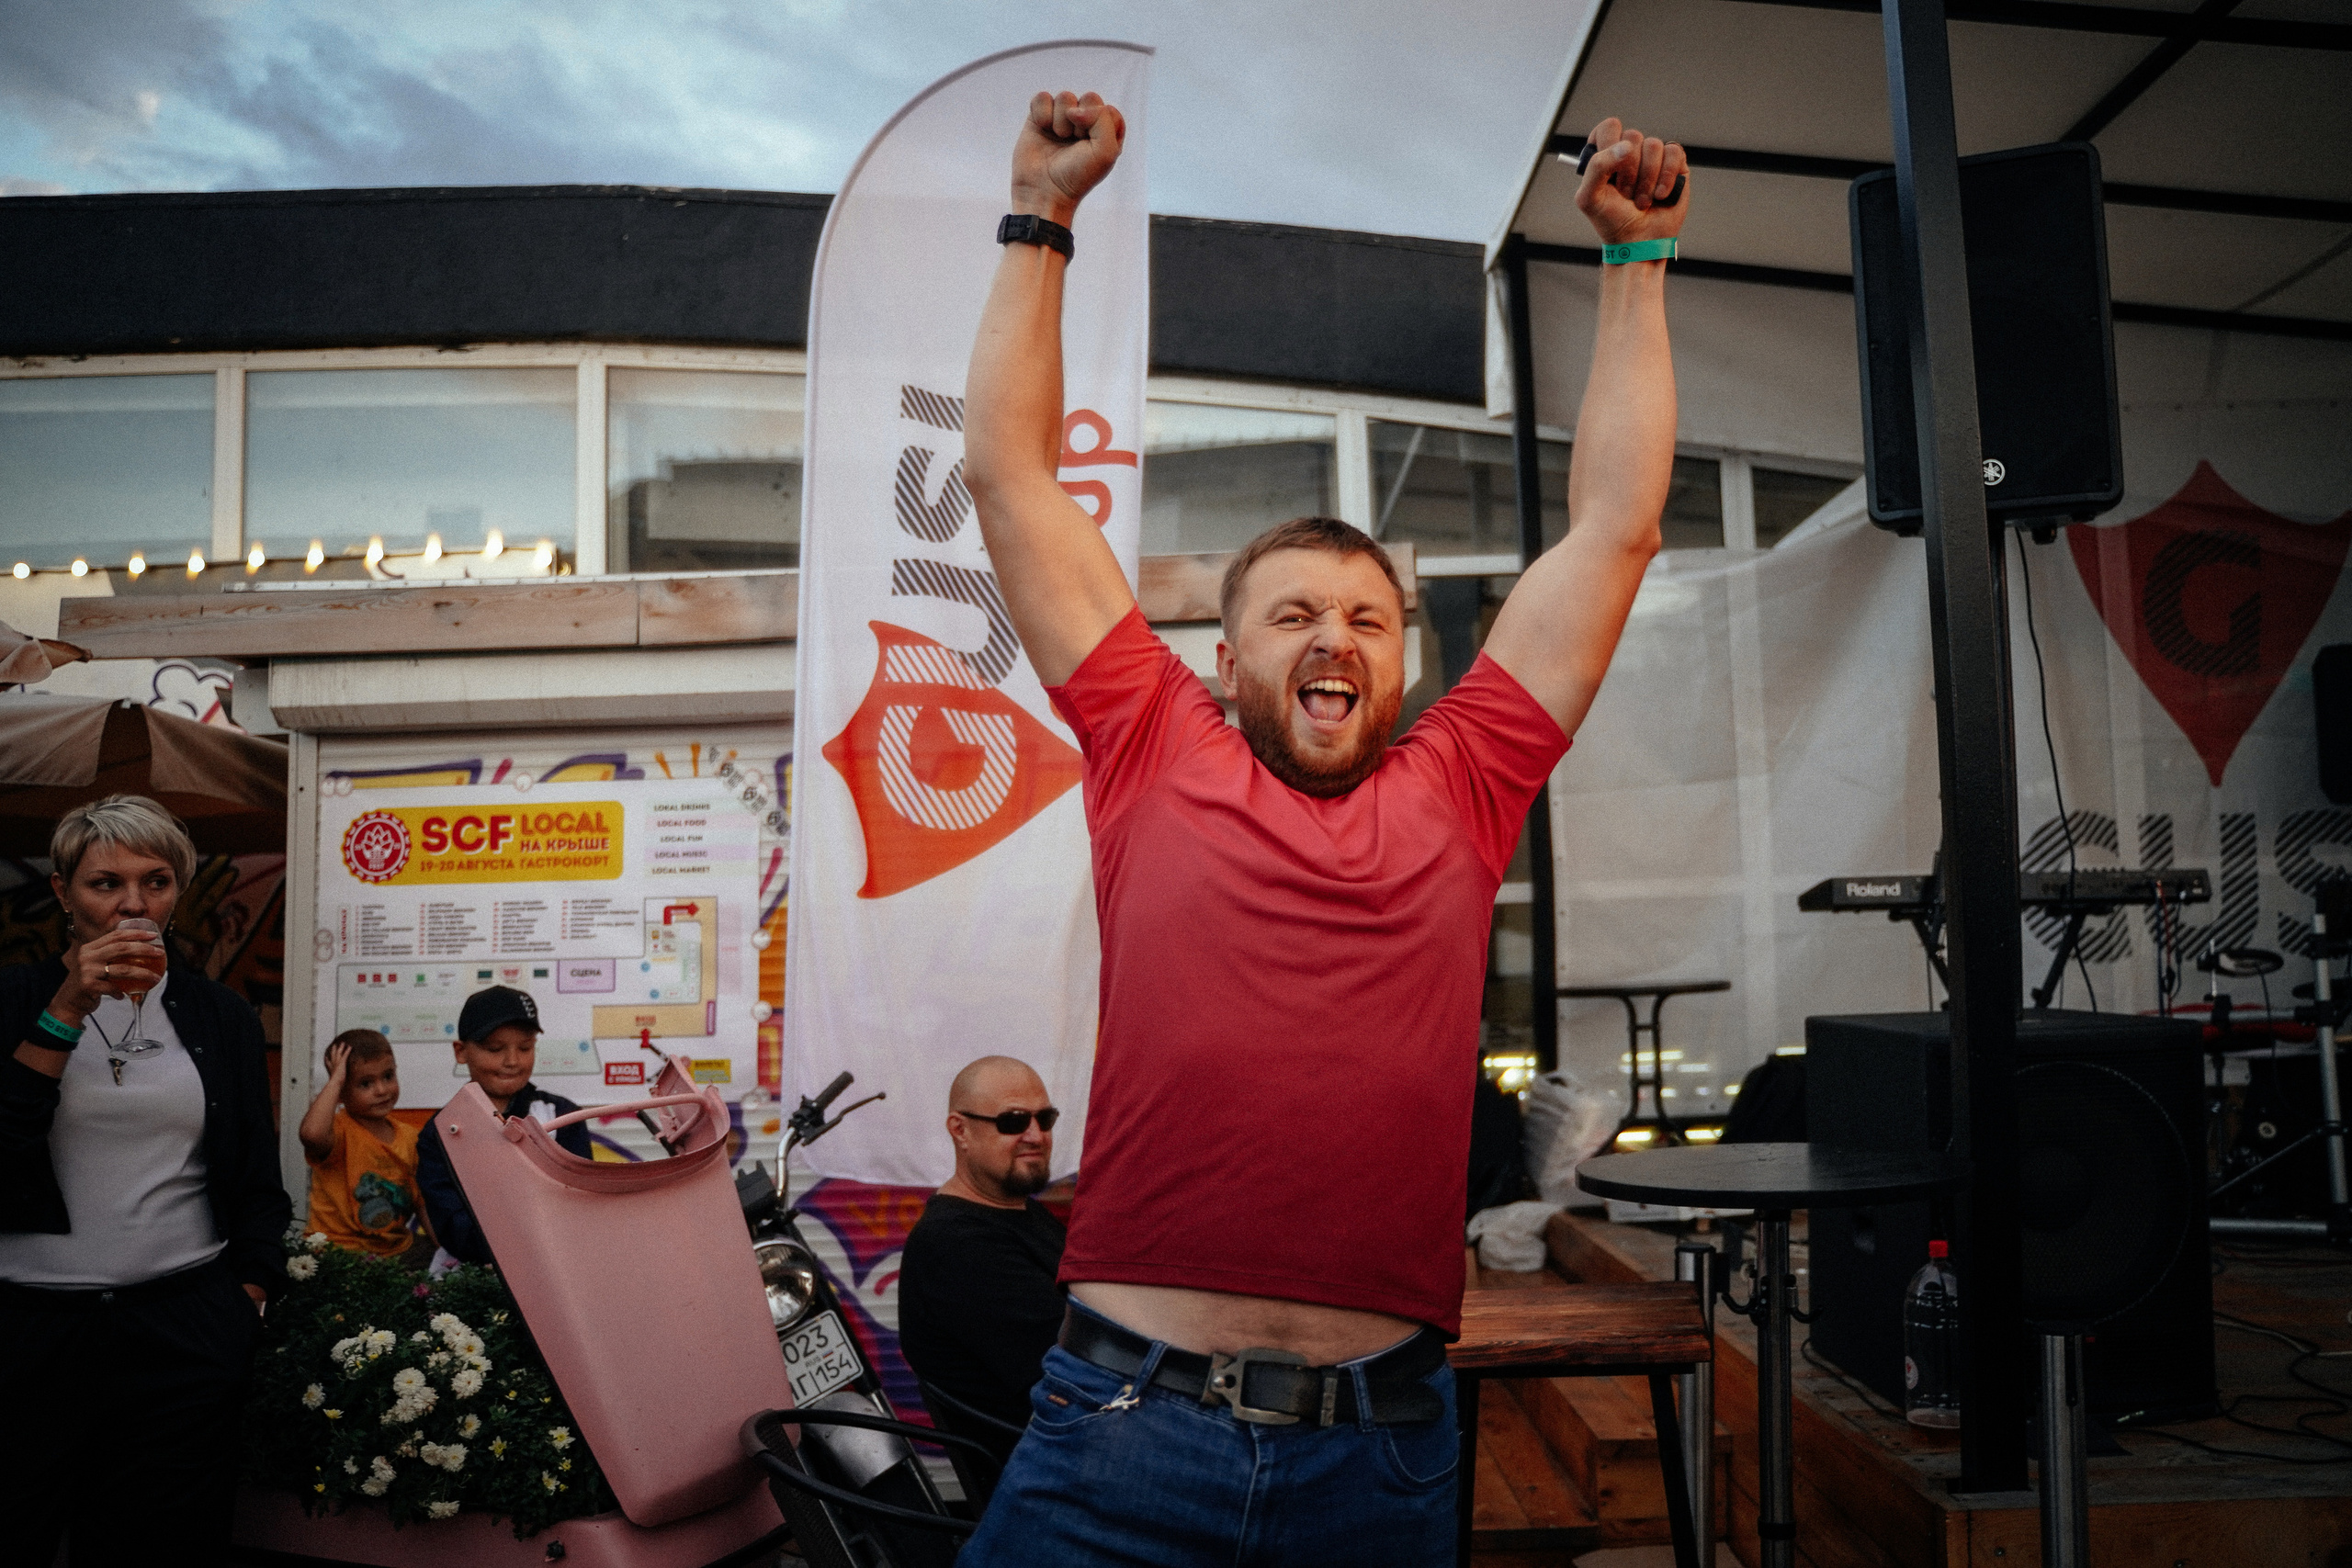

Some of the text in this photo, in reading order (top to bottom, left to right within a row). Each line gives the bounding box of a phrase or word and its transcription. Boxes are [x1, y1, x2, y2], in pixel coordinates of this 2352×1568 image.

[521, 811, 609, 836] LOCAL
[657, 819, 682, 828] LOCAL
[421, 815, 514, 855] SCF
[520, 837, 610, 853] НА КРЫШЕ
[457, 858, 514, 871] АВГУСТА
[1846, 882, 1901, 897] Roland
[570, 967, 602, 978] СЦЕНА
[609, 1065, 639, 1076] ВХОД
[815, 1353, 853, 1382] 154
